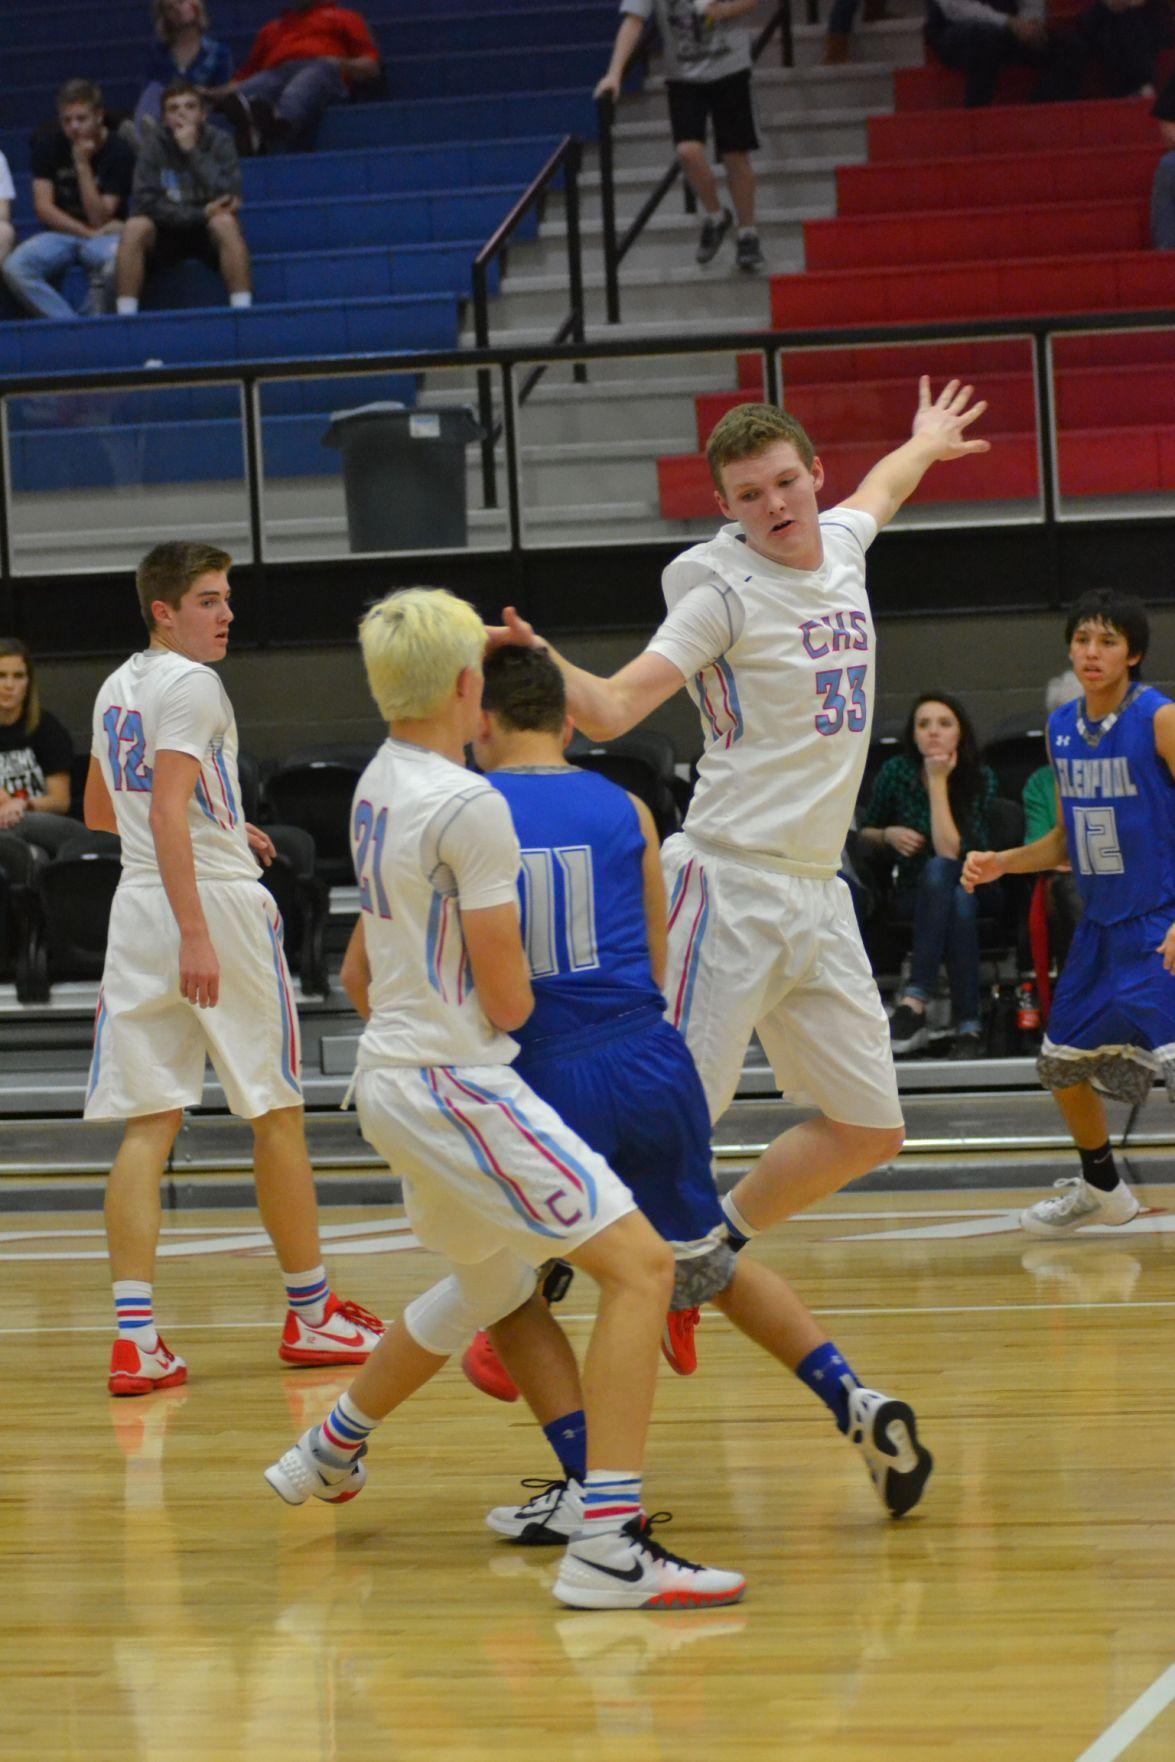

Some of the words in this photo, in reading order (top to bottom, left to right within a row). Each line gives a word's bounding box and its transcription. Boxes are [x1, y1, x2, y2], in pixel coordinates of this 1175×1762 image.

[799, 609, 868, 659] CHS
[815, 665, 867, 736] 33
[103, 705, 153, 792] 12
[354, 799, 393, 920] 21
[1072, 806, 1125, 875] 12
[520, 845, 600, 979] 11
[546, 1188, 583, 1227] C
